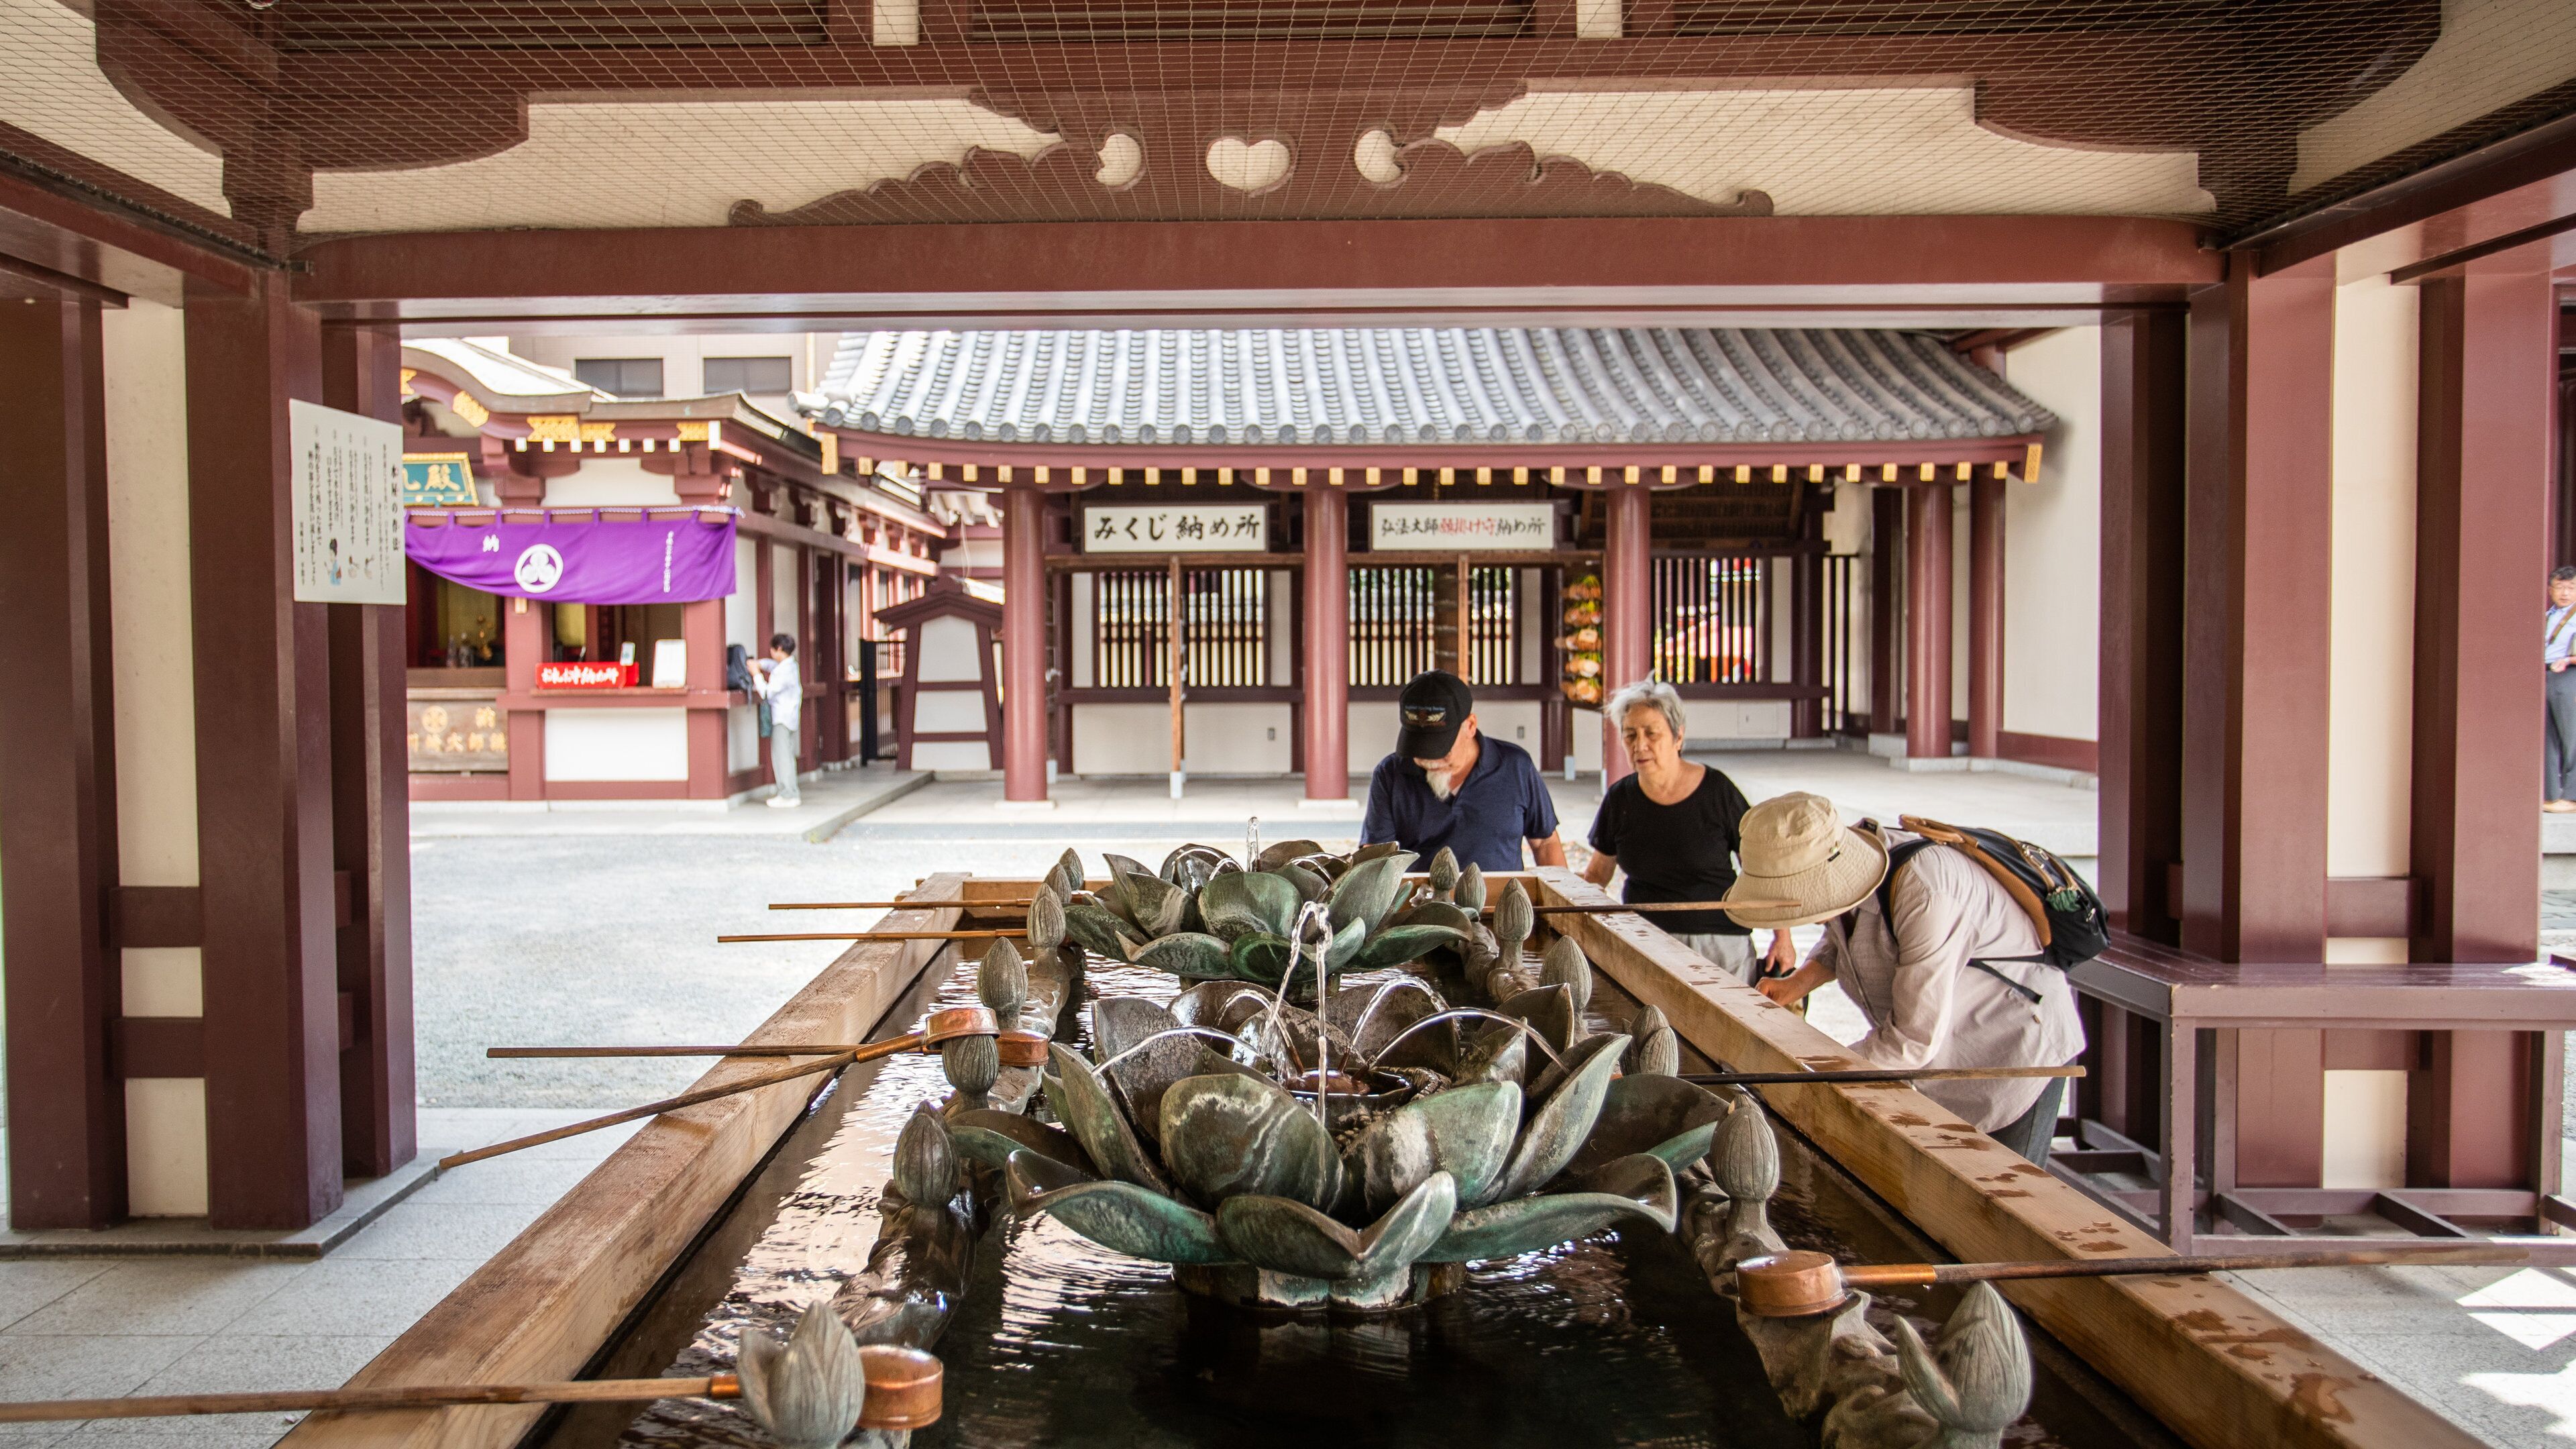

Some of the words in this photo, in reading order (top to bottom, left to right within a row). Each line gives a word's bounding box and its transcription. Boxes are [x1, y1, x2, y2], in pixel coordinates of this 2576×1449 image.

[1094, 513, 1260, 541] みくじ納め所
